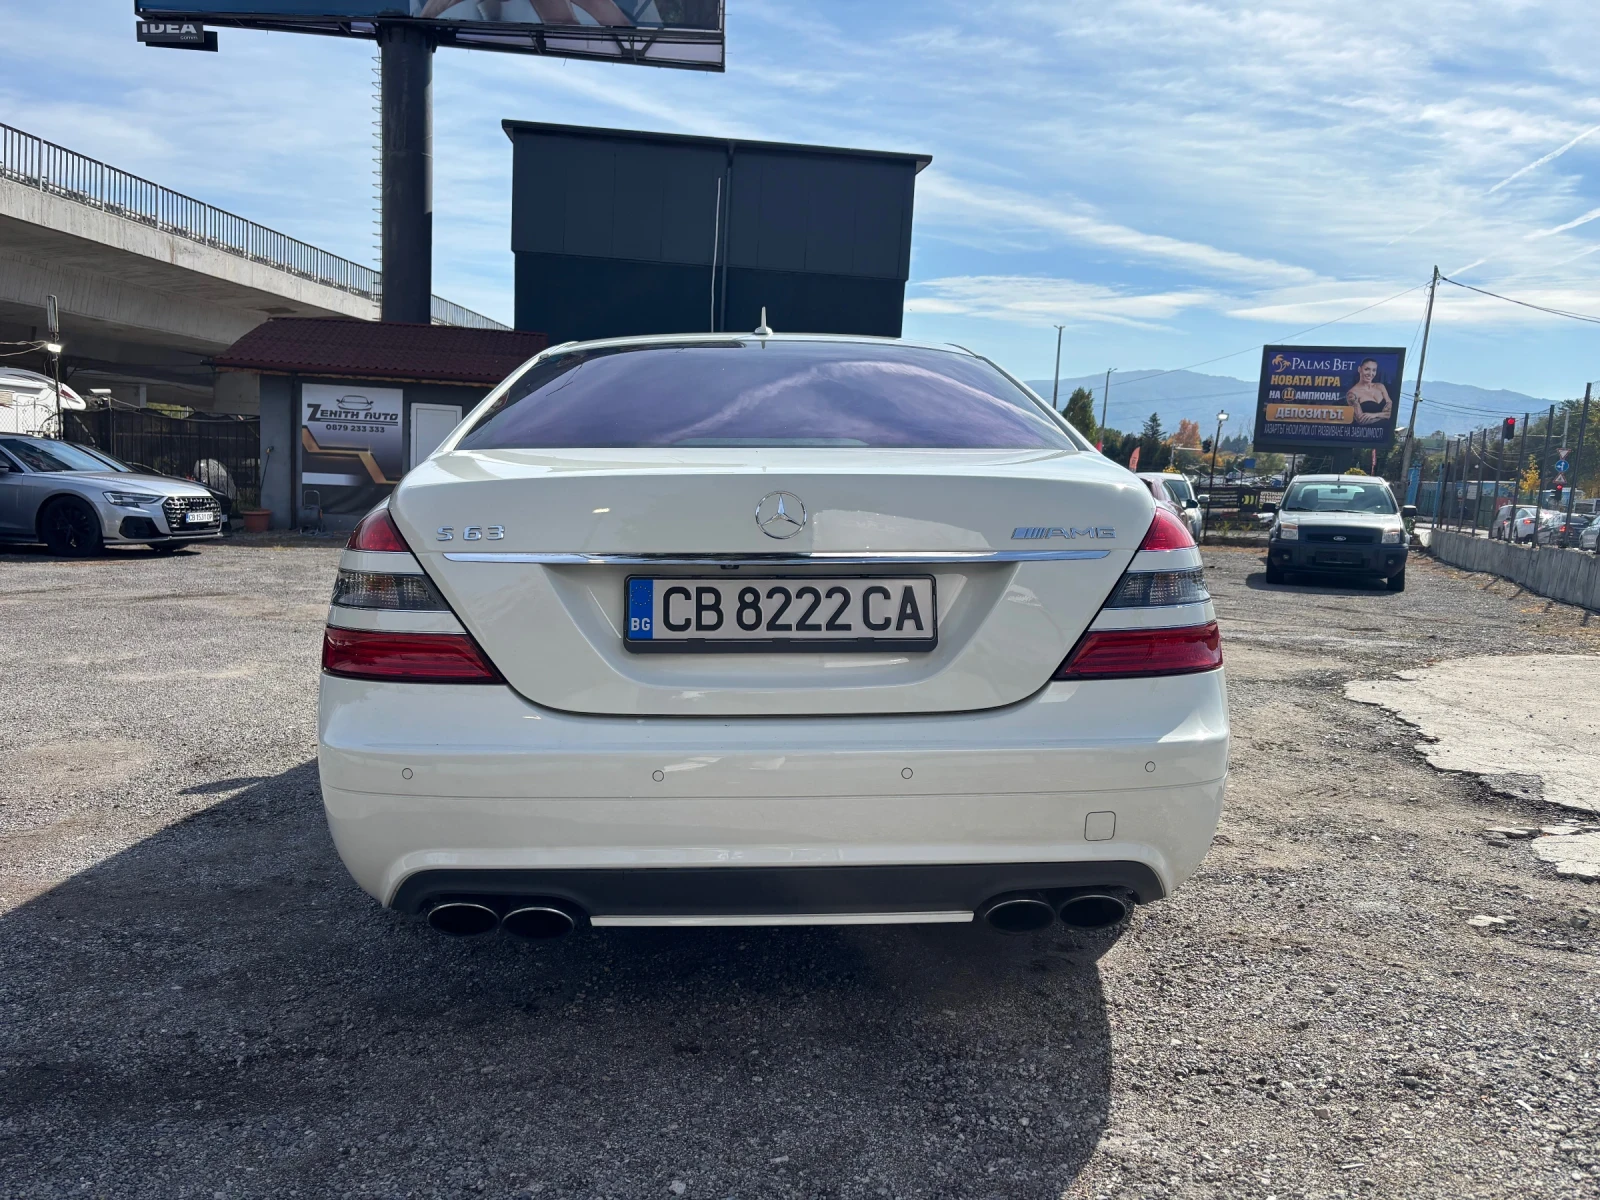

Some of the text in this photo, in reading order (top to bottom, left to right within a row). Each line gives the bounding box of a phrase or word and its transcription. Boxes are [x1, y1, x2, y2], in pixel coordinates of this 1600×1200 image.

[141, 24, 197, 34] IDEA
[1291, 357, 1356, 371] PALMS BET
[1270, 374, 1341, 387] НОВАТА ИГРА
[1268, 390, 1281, 399] НА
[307, 403, 399, 421] ZENITH AUTO
[1275, 407, 1345, 420] ДЕПОЗИТЪТ.
[325, 423, 385, 433] 0879 233 333
[436, 525, 505, 541] S 63
[1045, 526, 1116, 539] AMG
[662, 585, 924, 632] CB 8222 CA
[630, 618, 650, 631] BG
